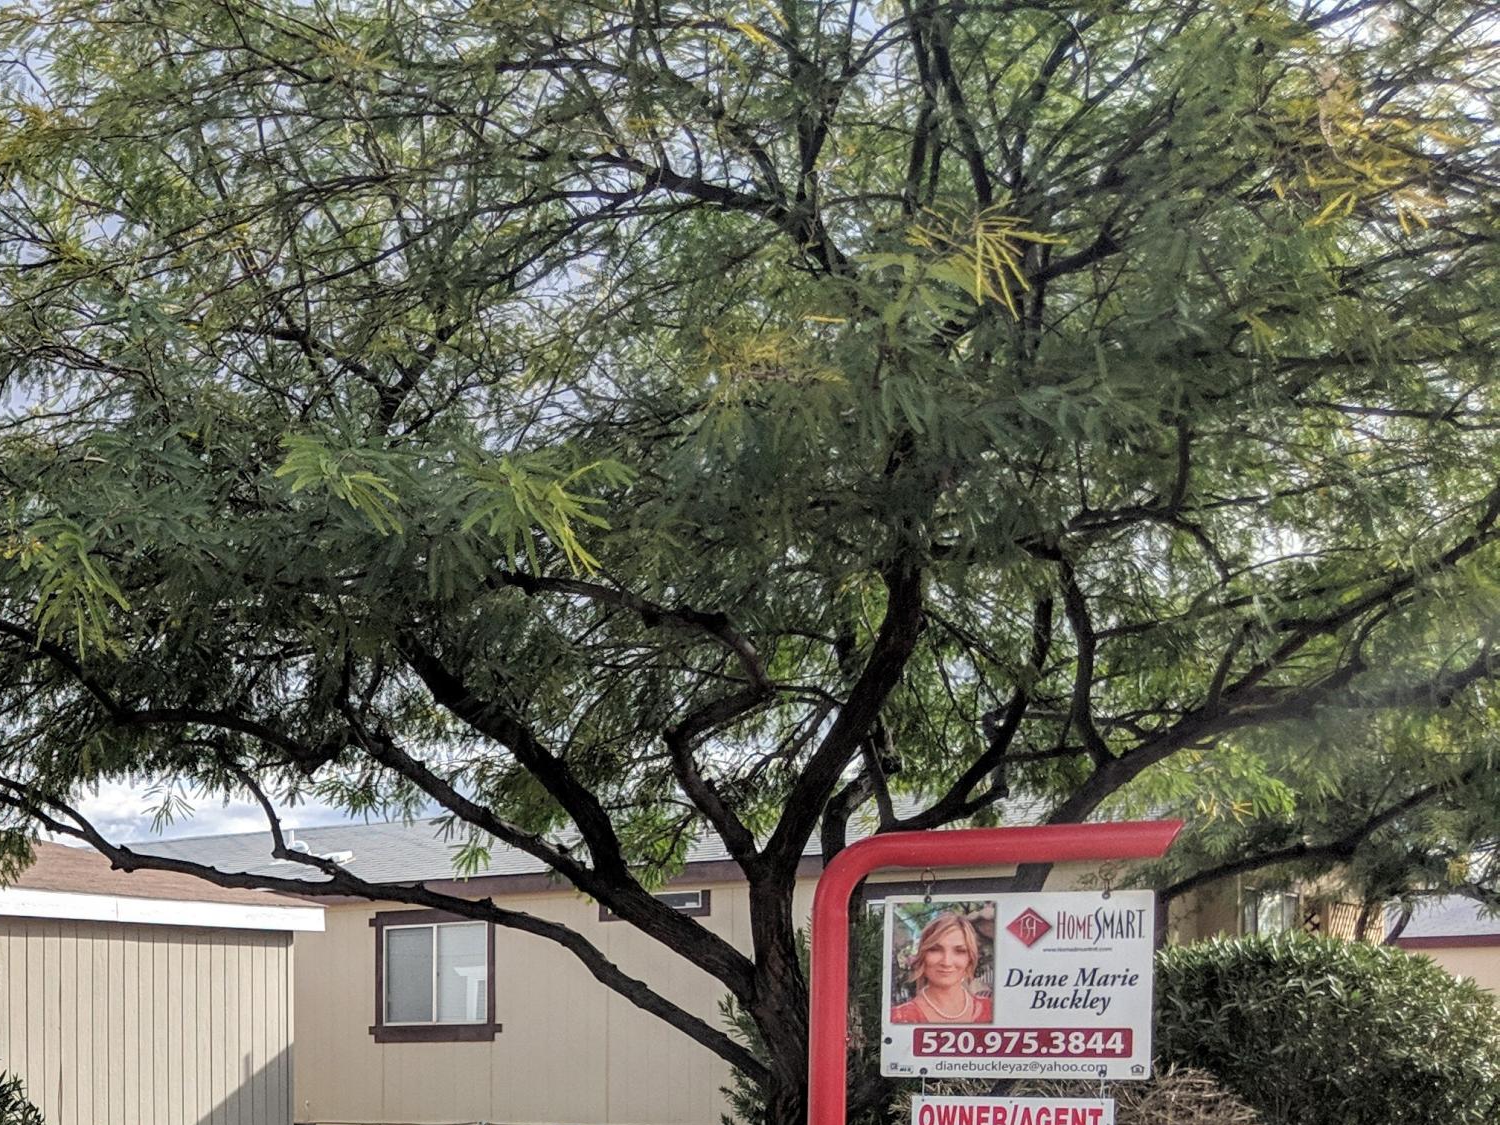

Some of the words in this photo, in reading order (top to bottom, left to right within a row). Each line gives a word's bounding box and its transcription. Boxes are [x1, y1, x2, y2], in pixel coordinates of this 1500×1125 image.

[1004, 967, 1069, 988] Diane
[1075, 967, 1139, 988] Marie
[1029, 989, 1111, 1015] Buckley
[921, 1031, 1125, 1054] 520.975.3844
[935, 1060, 1108, 1074] dianebuckleyaz@yahoo.com
